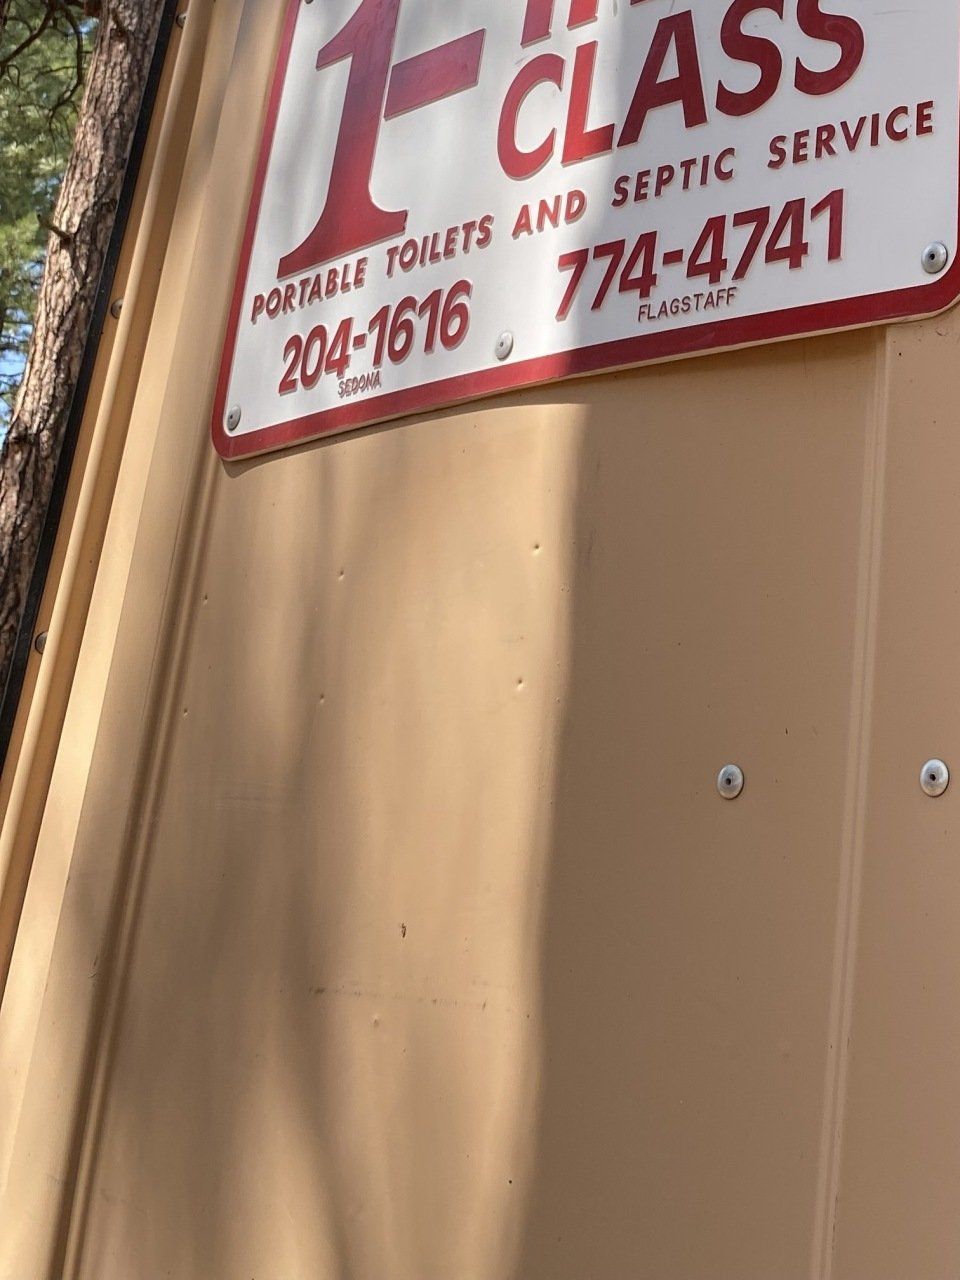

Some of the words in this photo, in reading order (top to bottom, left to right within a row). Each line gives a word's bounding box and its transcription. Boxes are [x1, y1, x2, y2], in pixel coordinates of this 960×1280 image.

[251, 257, 368, 323] PORTABLE
[386, 215, 494, 277] TOILETS
[512, 190, 587, 239] AND
[611, 148, 735, 207] SEPTIC
[767, 101, 935, 169] SERVICE
[555, 189, 844, 321] 774-4741
[278, 280, 473, 396] 204-1616
[637, 287, 738, 322] FLAGSTAFF
[338, 370, 381, 398] SEDONA
